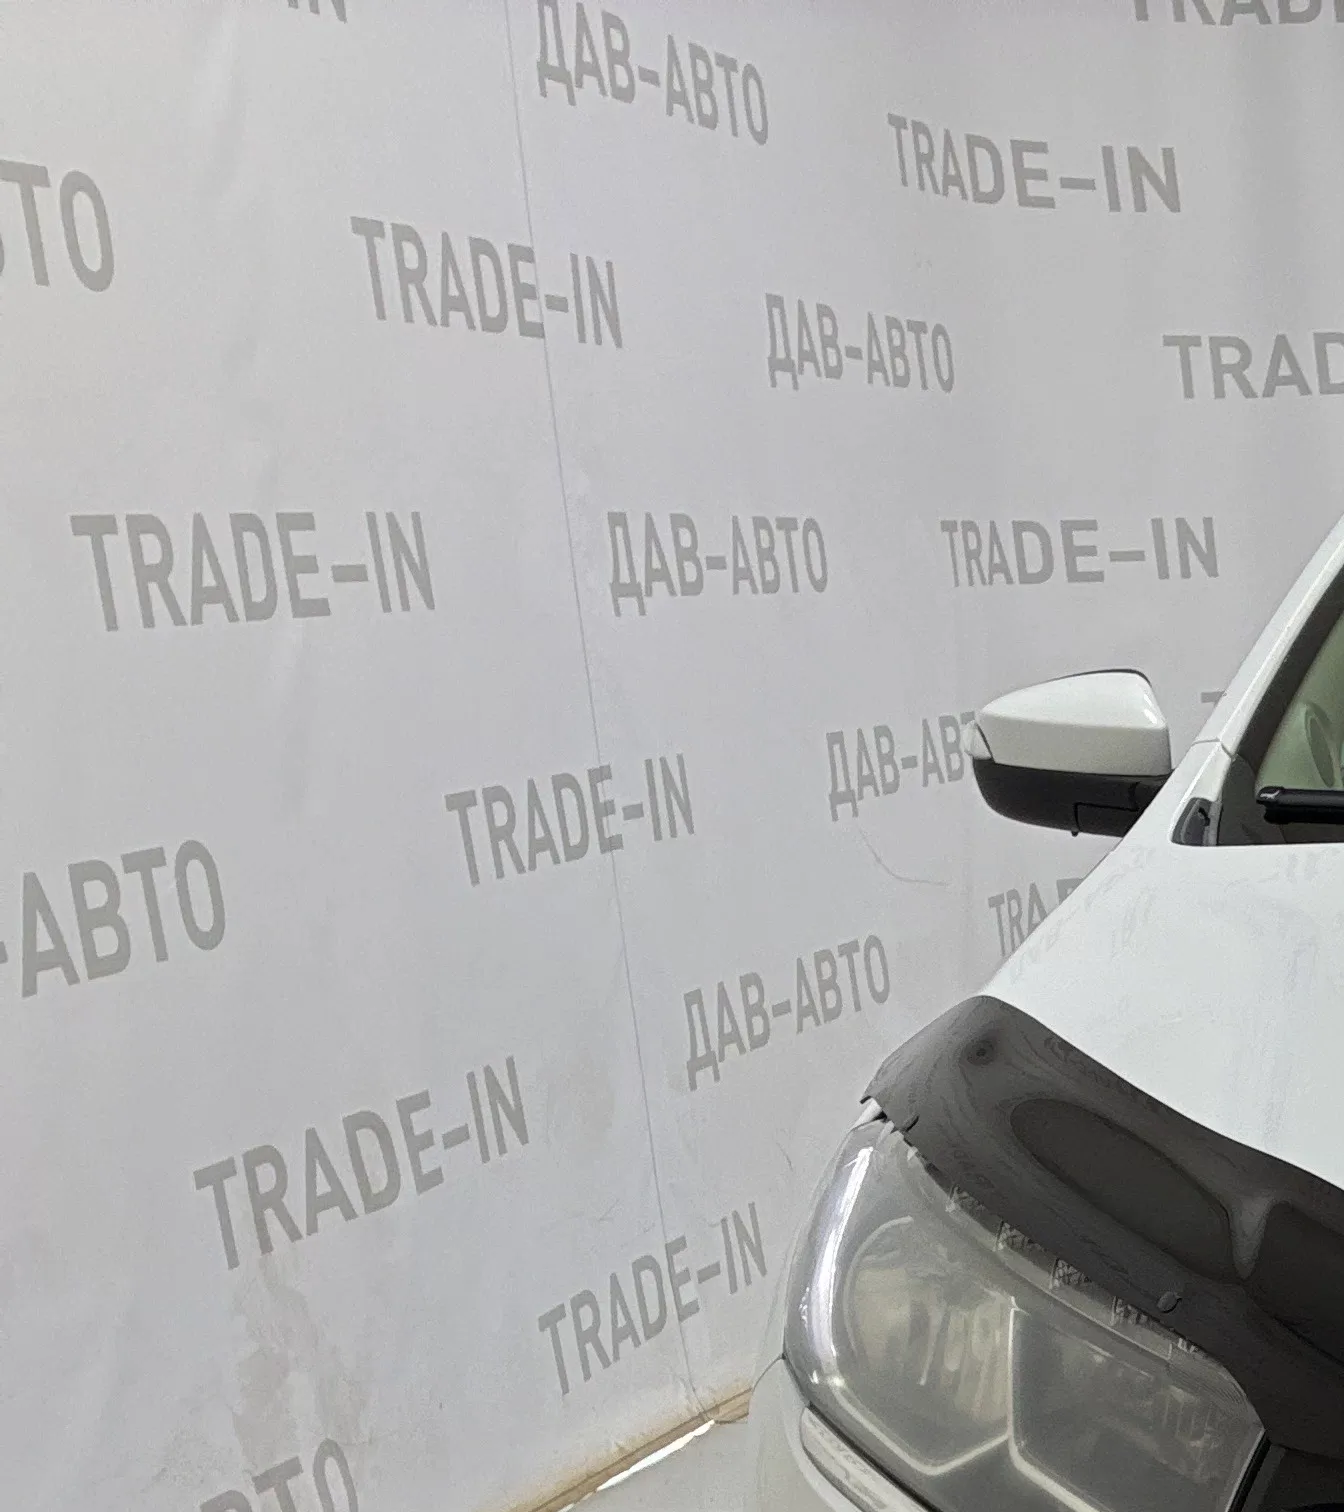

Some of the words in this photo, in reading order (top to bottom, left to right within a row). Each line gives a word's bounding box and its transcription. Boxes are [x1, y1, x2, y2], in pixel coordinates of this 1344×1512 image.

[537, 0, 768, 145] ДАВ-АВТО
[887, 113, 1182, 213] TRADE-IN
[351, 217, 623, 349] TRADE-IN
[766, 294, 954, 394] ДАВ-АВТО
[71, 512, 435, 632] TRADE-IN
[606, 512, 829, 617] ДАВ-АВТО
[941, 517, 1219, 588] TRADE-IN
[445, 753, 696, 886] TRADE-IN
[684, 935, 891, 1091] ДАВ-АВТО
[194, 1056, 529, 1270] TRADE-IN
[538, 1202, 768, 1396] TRADE-IN
